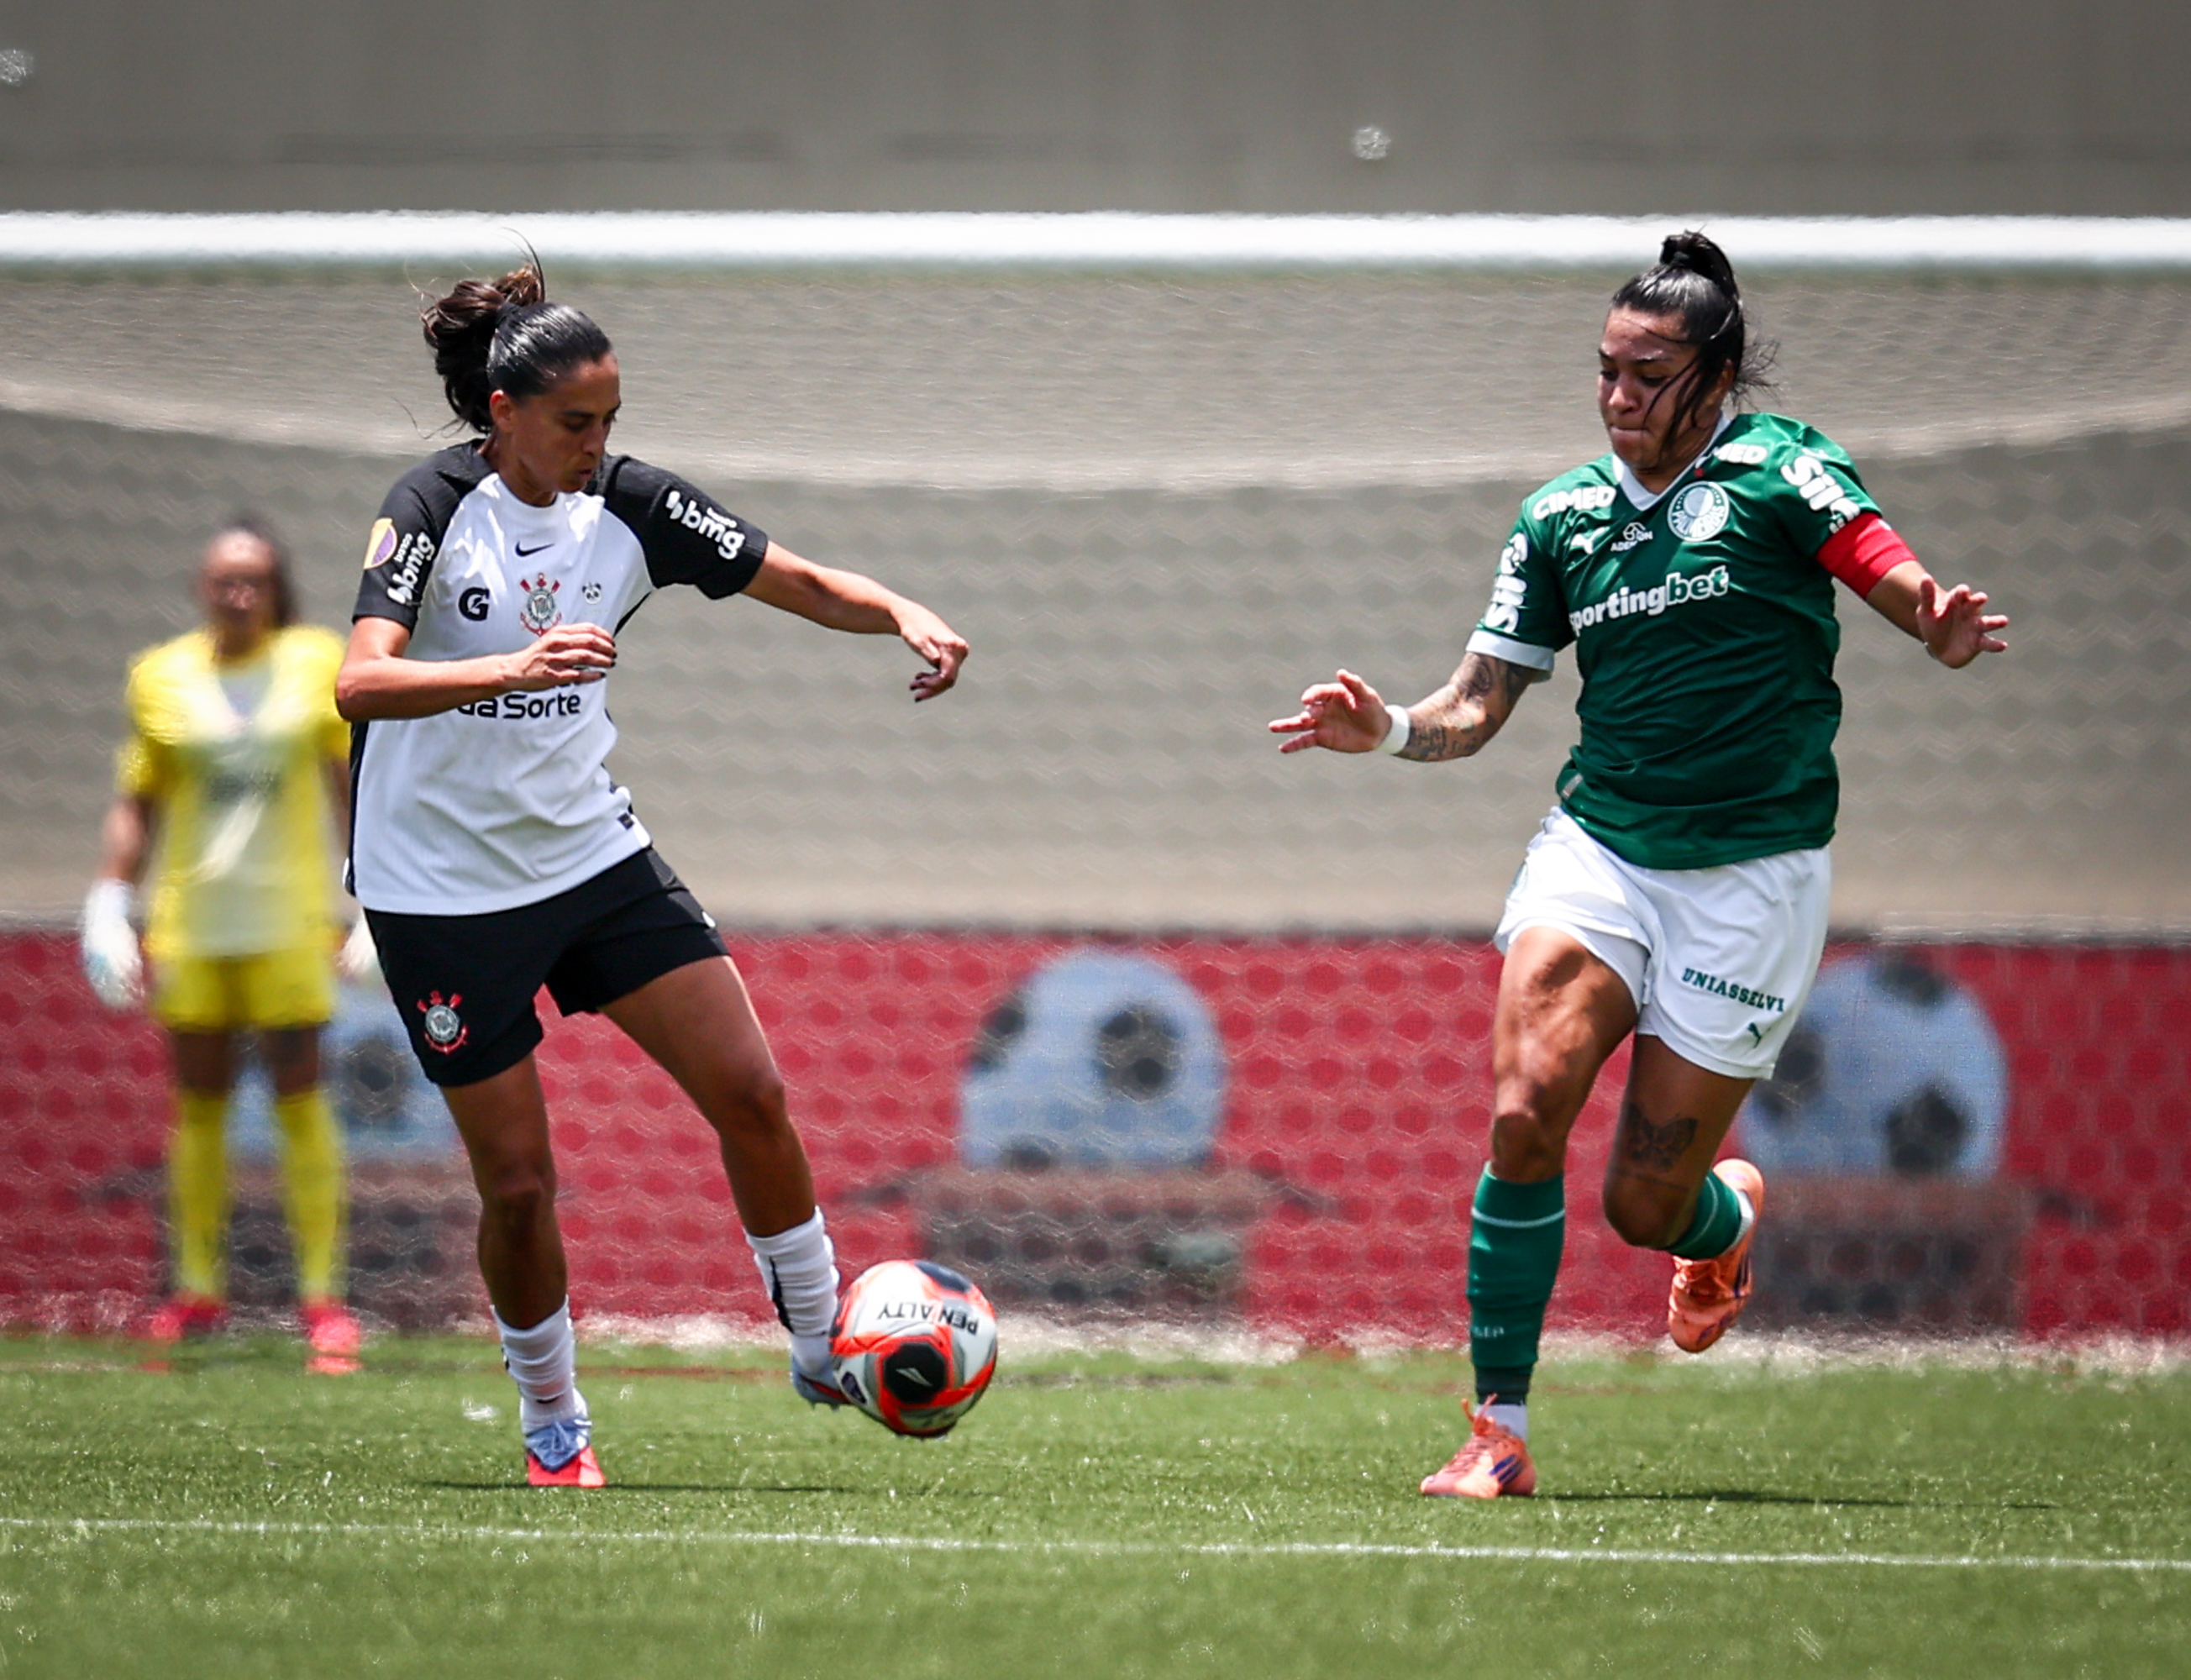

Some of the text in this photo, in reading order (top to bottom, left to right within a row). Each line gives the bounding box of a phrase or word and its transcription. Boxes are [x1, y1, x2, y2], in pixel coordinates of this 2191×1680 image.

[1532, 486, 1617, 521] CIMED
[680, 499, 746, 560] bmg
[391, 531, 436, 590] bmg
[458, 586, 491, 622] G
[503, 692, 581, 719] Sorte
[1682, 967, 1785, 1012] UNIASSELVI
[876, 1301, 980, 1336] PENALTY
